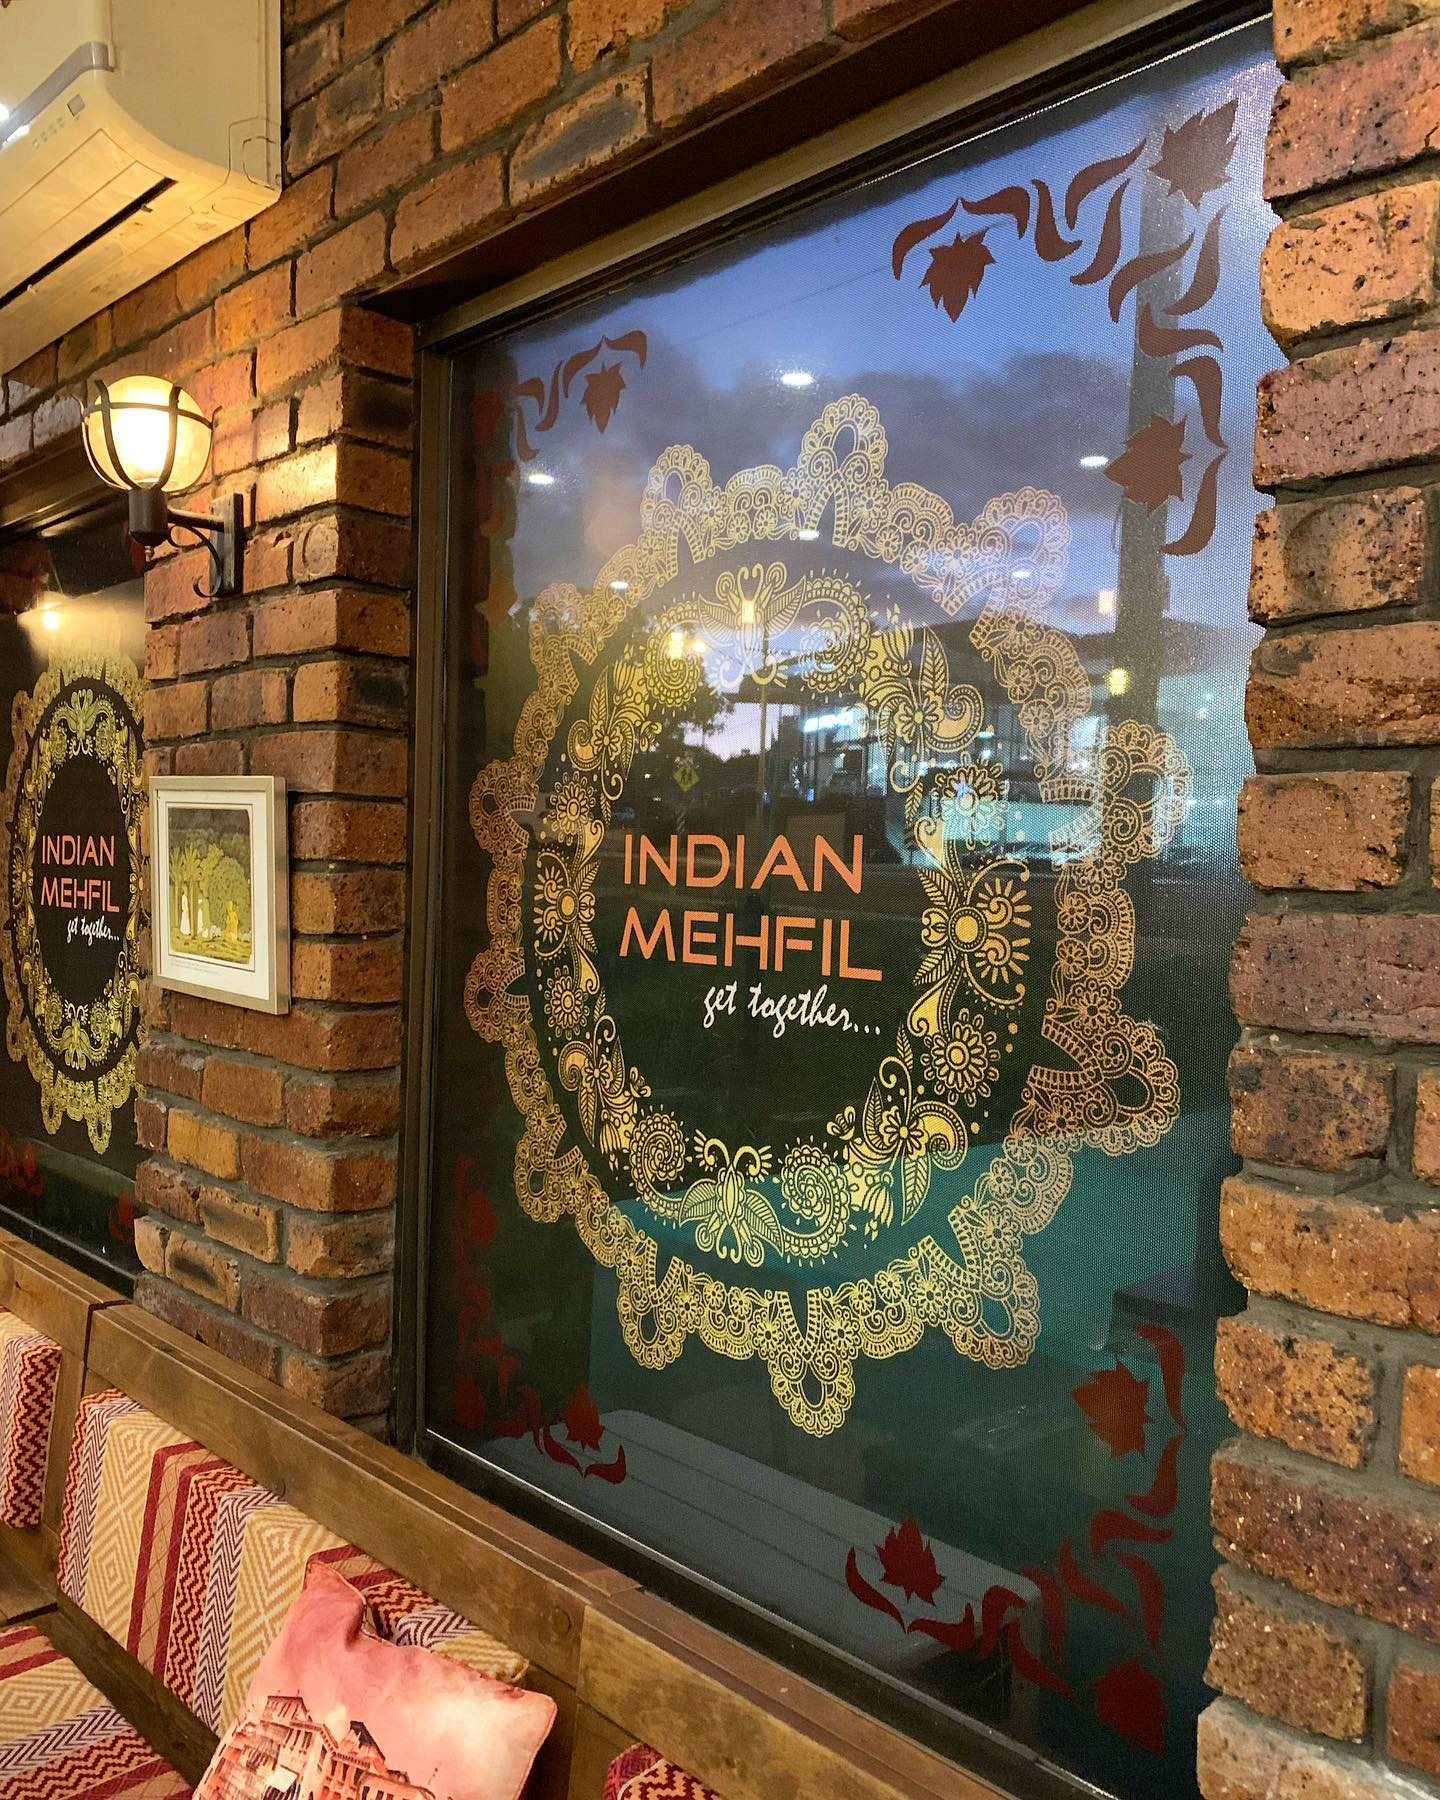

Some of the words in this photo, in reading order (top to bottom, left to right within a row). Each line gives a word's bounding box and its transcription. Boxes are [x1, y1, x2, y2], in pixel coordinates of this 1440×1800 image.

[42, 835, 114, 867] INDIAN
[624, 834, 864, 894] INDIAN
[41, 876, 120, 913] MEHFIL
[66, 915, 79, 944] get
[618, 906, 883, 982] MEHFIL
[703, 980, 738, 1029] get
[747, 982, 881, 1039] together...
